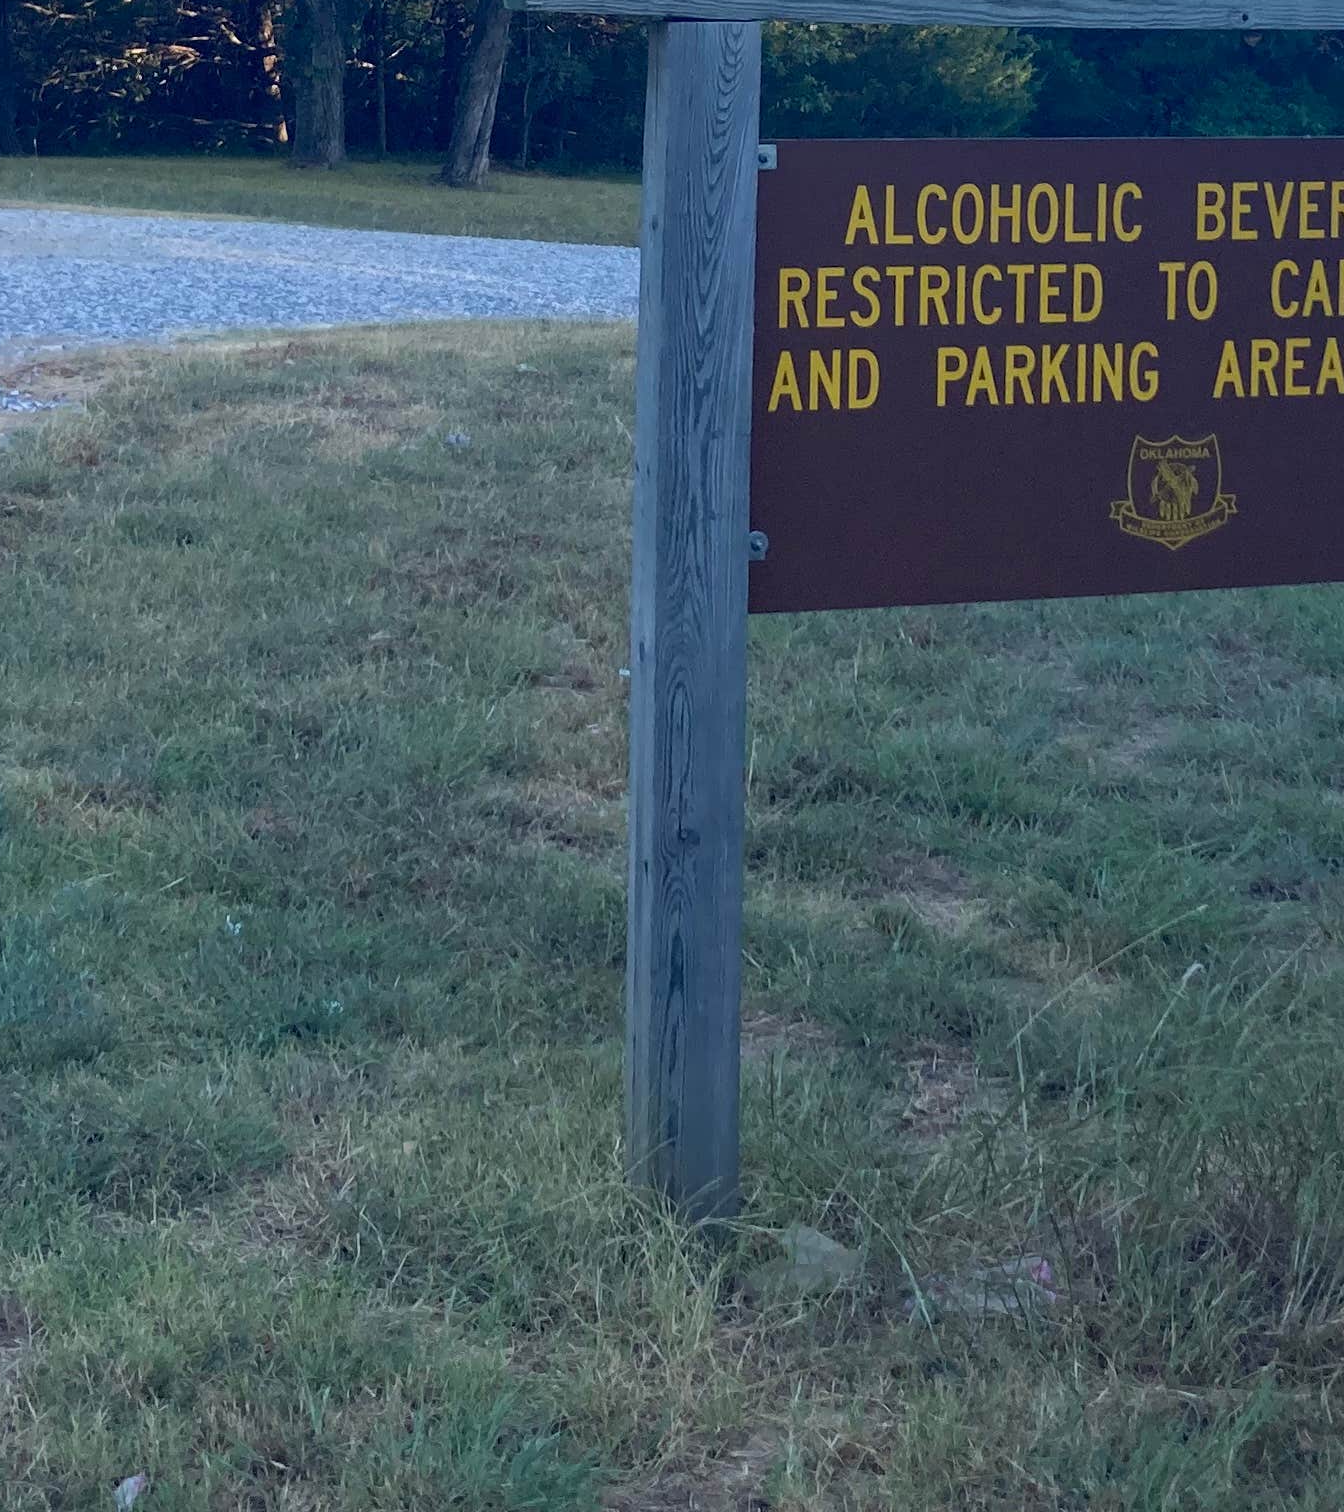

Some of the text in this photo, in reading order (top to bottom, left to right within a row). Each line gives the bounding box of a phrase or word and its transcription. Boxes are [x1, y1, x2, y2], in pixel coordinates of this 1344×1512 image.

[845, 183, 1143, 245] ALCOHOLIC
[778, 265, 1103, 329] RESTRICTED
[1159, 261, 1218, 320] TO
[768, 349, 879, 411] AND
[937, 341, 1159, 407] PARKING
[1140, 447, 1211, 460] OKLAHOMA
